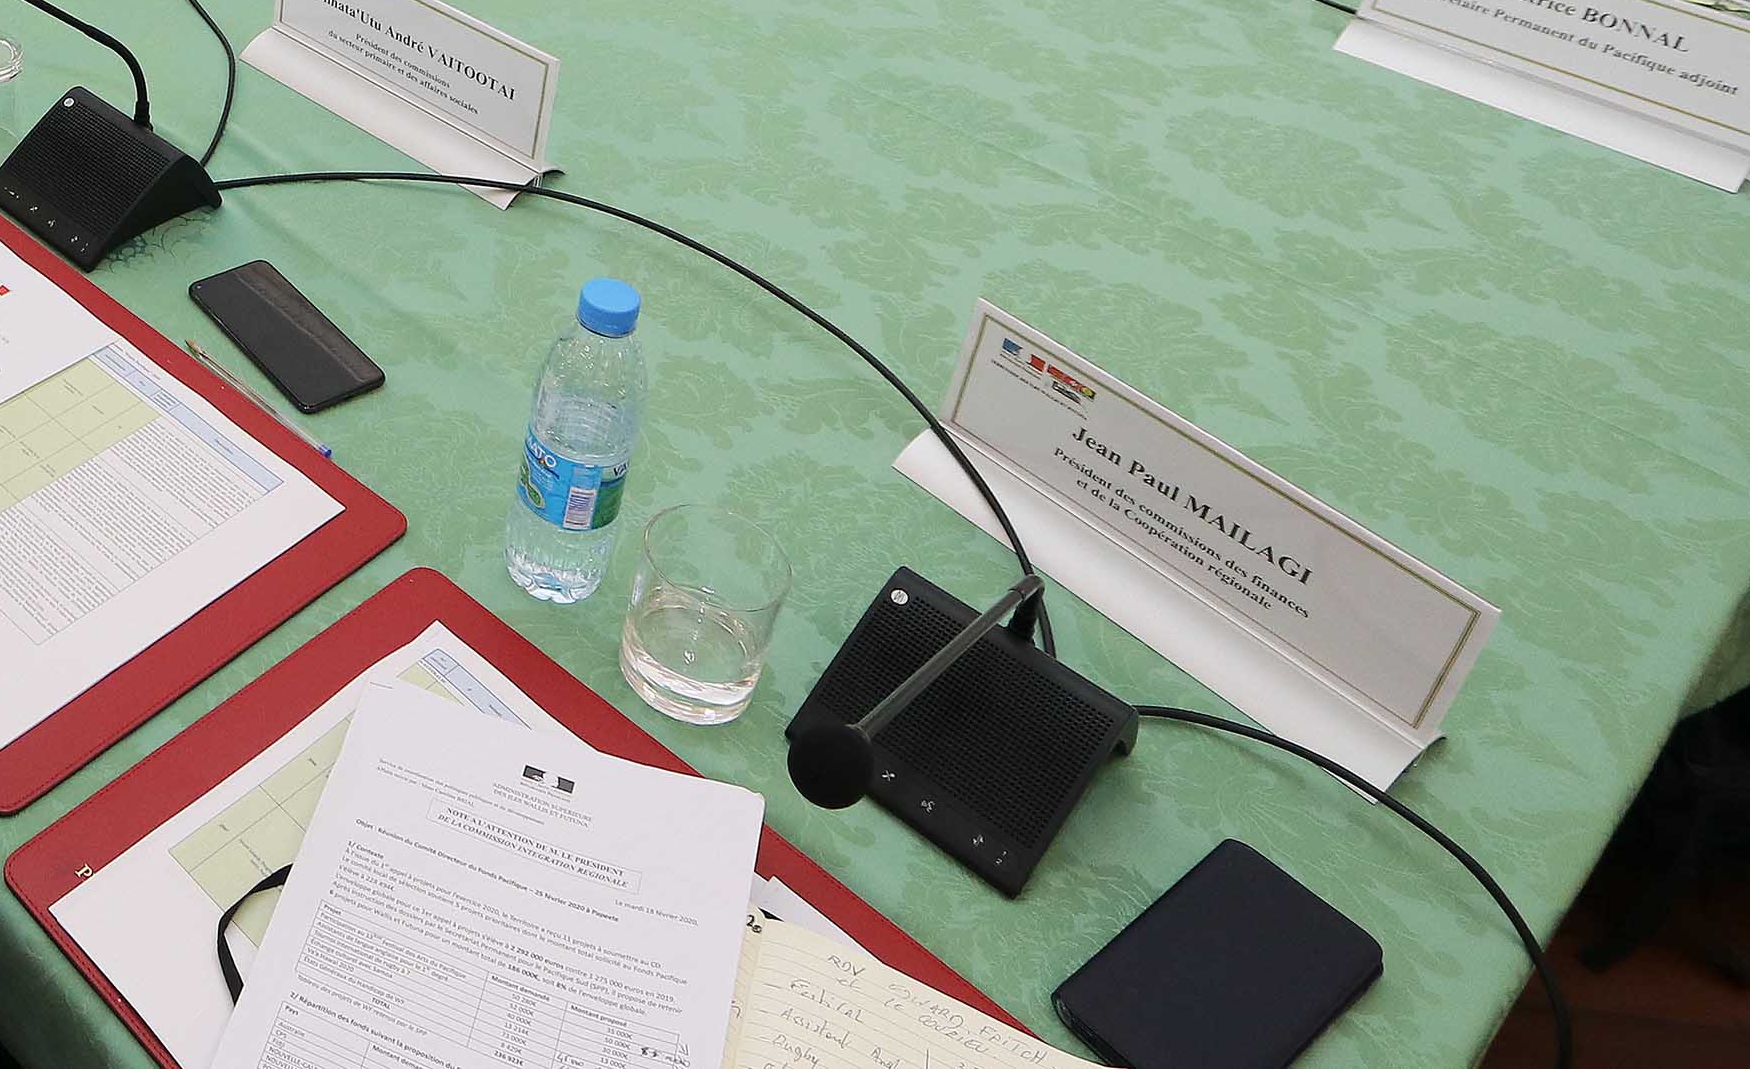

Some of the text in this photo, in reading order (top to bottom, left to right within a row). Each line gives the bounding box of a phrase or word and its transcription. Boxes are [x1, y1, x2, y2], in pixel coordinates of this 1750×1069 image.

[355, 33, 450, 88] Président des commissions
[1493, 8, 1574, 41] Permanent
[1577, 37, 1598, 50] du
[1601, 43, 1675, 74] Pacifique
[1678, 71, 1738, 95] adjoint
[1581, 7, 1687, 52] BONNAL
[327, 29, 338, 39] du
[338, 35, 364, 53] secteur
[364, 50, 396, 70] primaire
[405, 71, 418, 82] des
[419, 79, 447, 98] affaires
[449, 95, 478, 114] sociales
[384, 25, 423, 53] André
[428, 45, 514, 100] VAITOOTAI
[1054, 447, 1308, 618] Président des commissions des finances
[1072, 427, 1311, 584] Jean Paul MAILAGI
[1075, 479, 1271, 609] et de la Coopération régionale
[356, 844, 383, 859] Contexte
[356, 819, 373, 829] Objet
[378, 828, 403, 841] Réunion
[414, 842, 436, 854] Comité
[437, 851, 467, 865] Directeur
[478, 867, 496, 879] Fonds
[498, 875, 527, 890] Pacifique
[545, 893, 566, 904] février
[568, 901, 585, 911] 2020
[592, 909, 618, 921] Papeete
[448, 808, 467, 819] NOTE
[474, 820, 533, 845] L'ATTENTION
[575, 857, 622, 876] PRESIDENT
[463, 825, 516, 848] COMMISSION
[518, 846, 575, 870] INTEGRATION
[577, 867, 628, 887] REGIONALE
[324, 904, 341, 915] Projet
[285, 1005, 298, 1015] Pays
[372, 997, 389, 1009] TOTAL
[491, 975, 549, 1001] Montant demandé
[571, 1005, 627, 1027] Montant proposé
[299, 996, 336, 1017] Répartition
[350, 1019, 369, 1032] fonds
[371, 1029, 395, 1043] suivant
[404, 1045, 444, 1066] proposition
